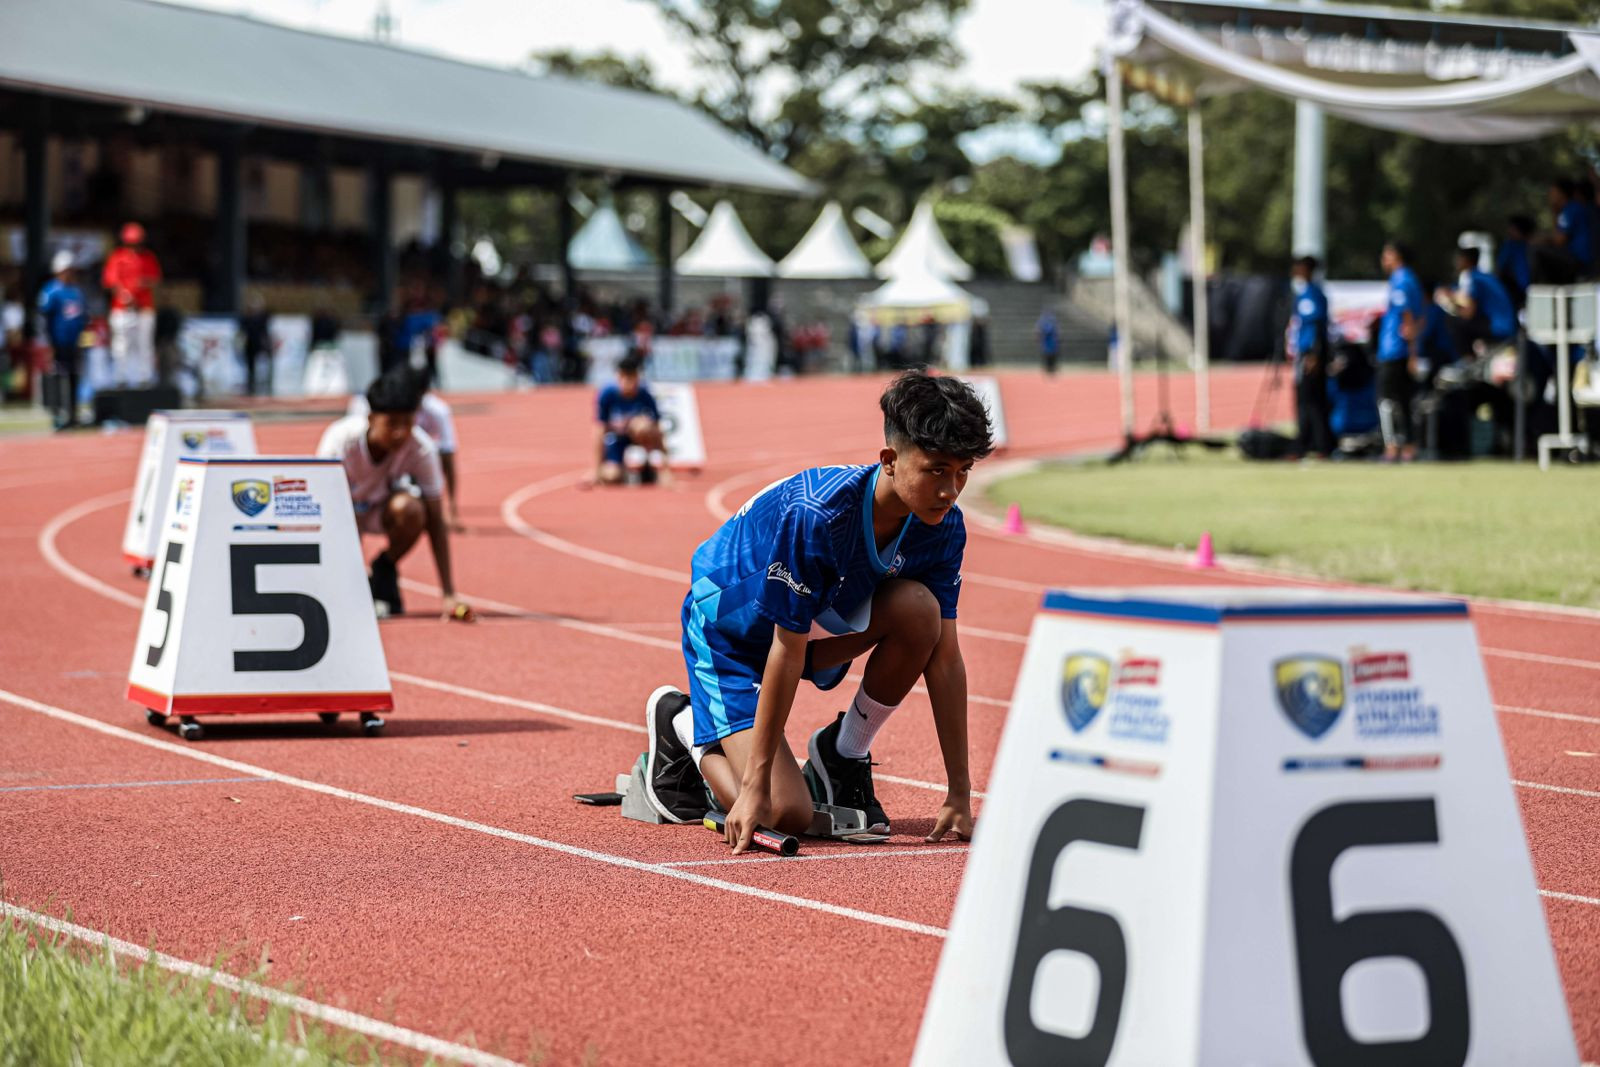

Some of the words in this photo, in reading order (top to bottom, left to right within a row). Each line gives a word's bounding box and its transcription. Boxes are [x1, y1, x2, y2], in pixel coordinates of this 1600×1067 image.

[147, 542, 183, 668] 5
[229, 543, 330, 673] 5
[1003, 798, 1146, 1067] 6
[1288, 797, 1471, 1067] 6
